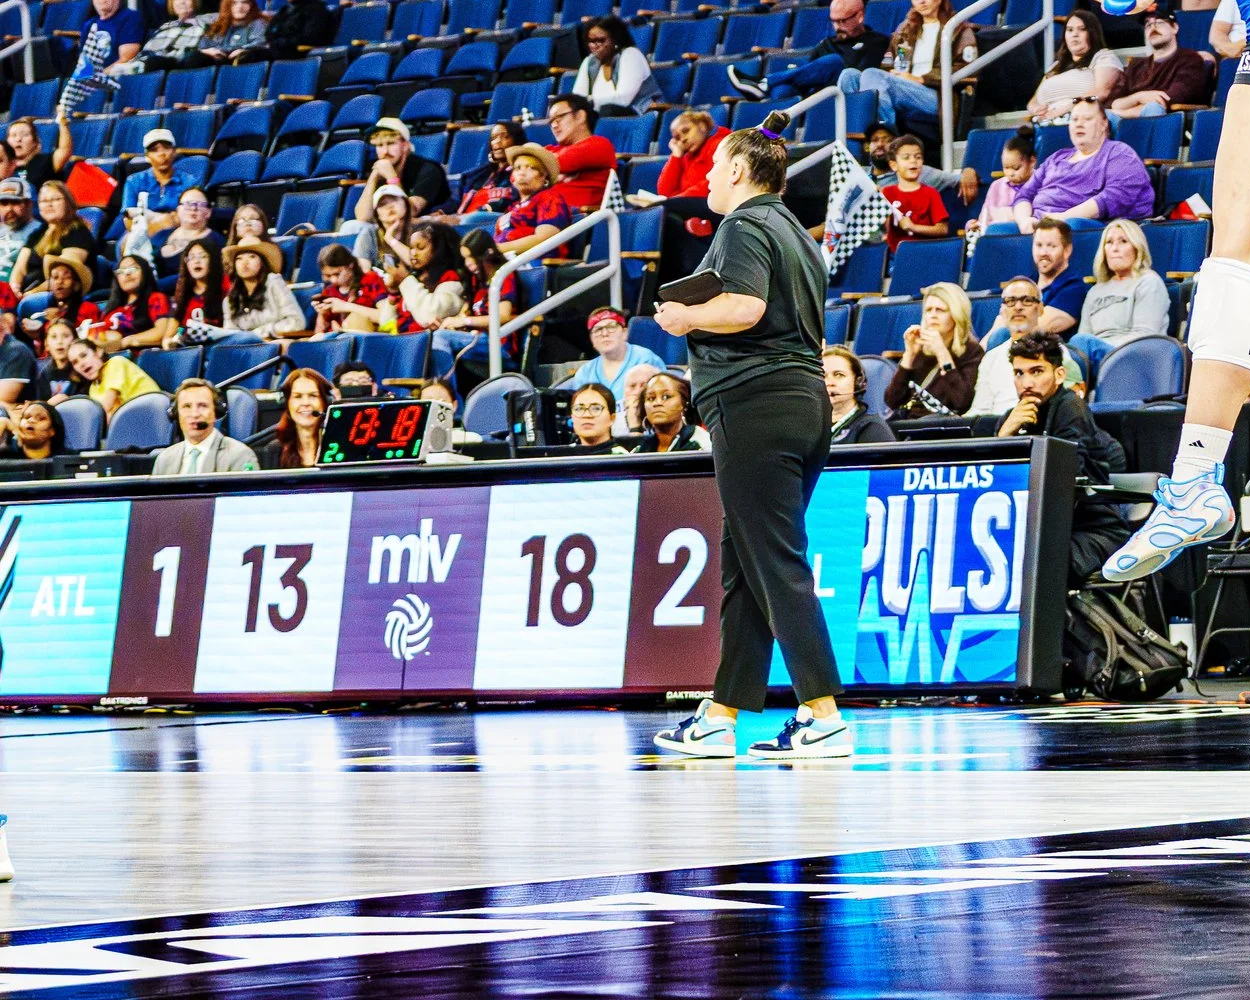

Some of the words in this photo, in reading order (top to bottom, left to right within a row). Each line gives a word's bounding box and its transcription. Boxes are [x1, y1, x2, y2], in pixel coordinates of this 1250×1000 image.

[903, 465, 994, 490] DALLAS
[152, 546, 181, 637] 1
[242, 543, 313, 632] 13
[368, 518, 462, 584] mlv
[520, 533, 597, 628] 18
[652, 527, 708, 626] 2
[30, 575, 95, 617] ATL
